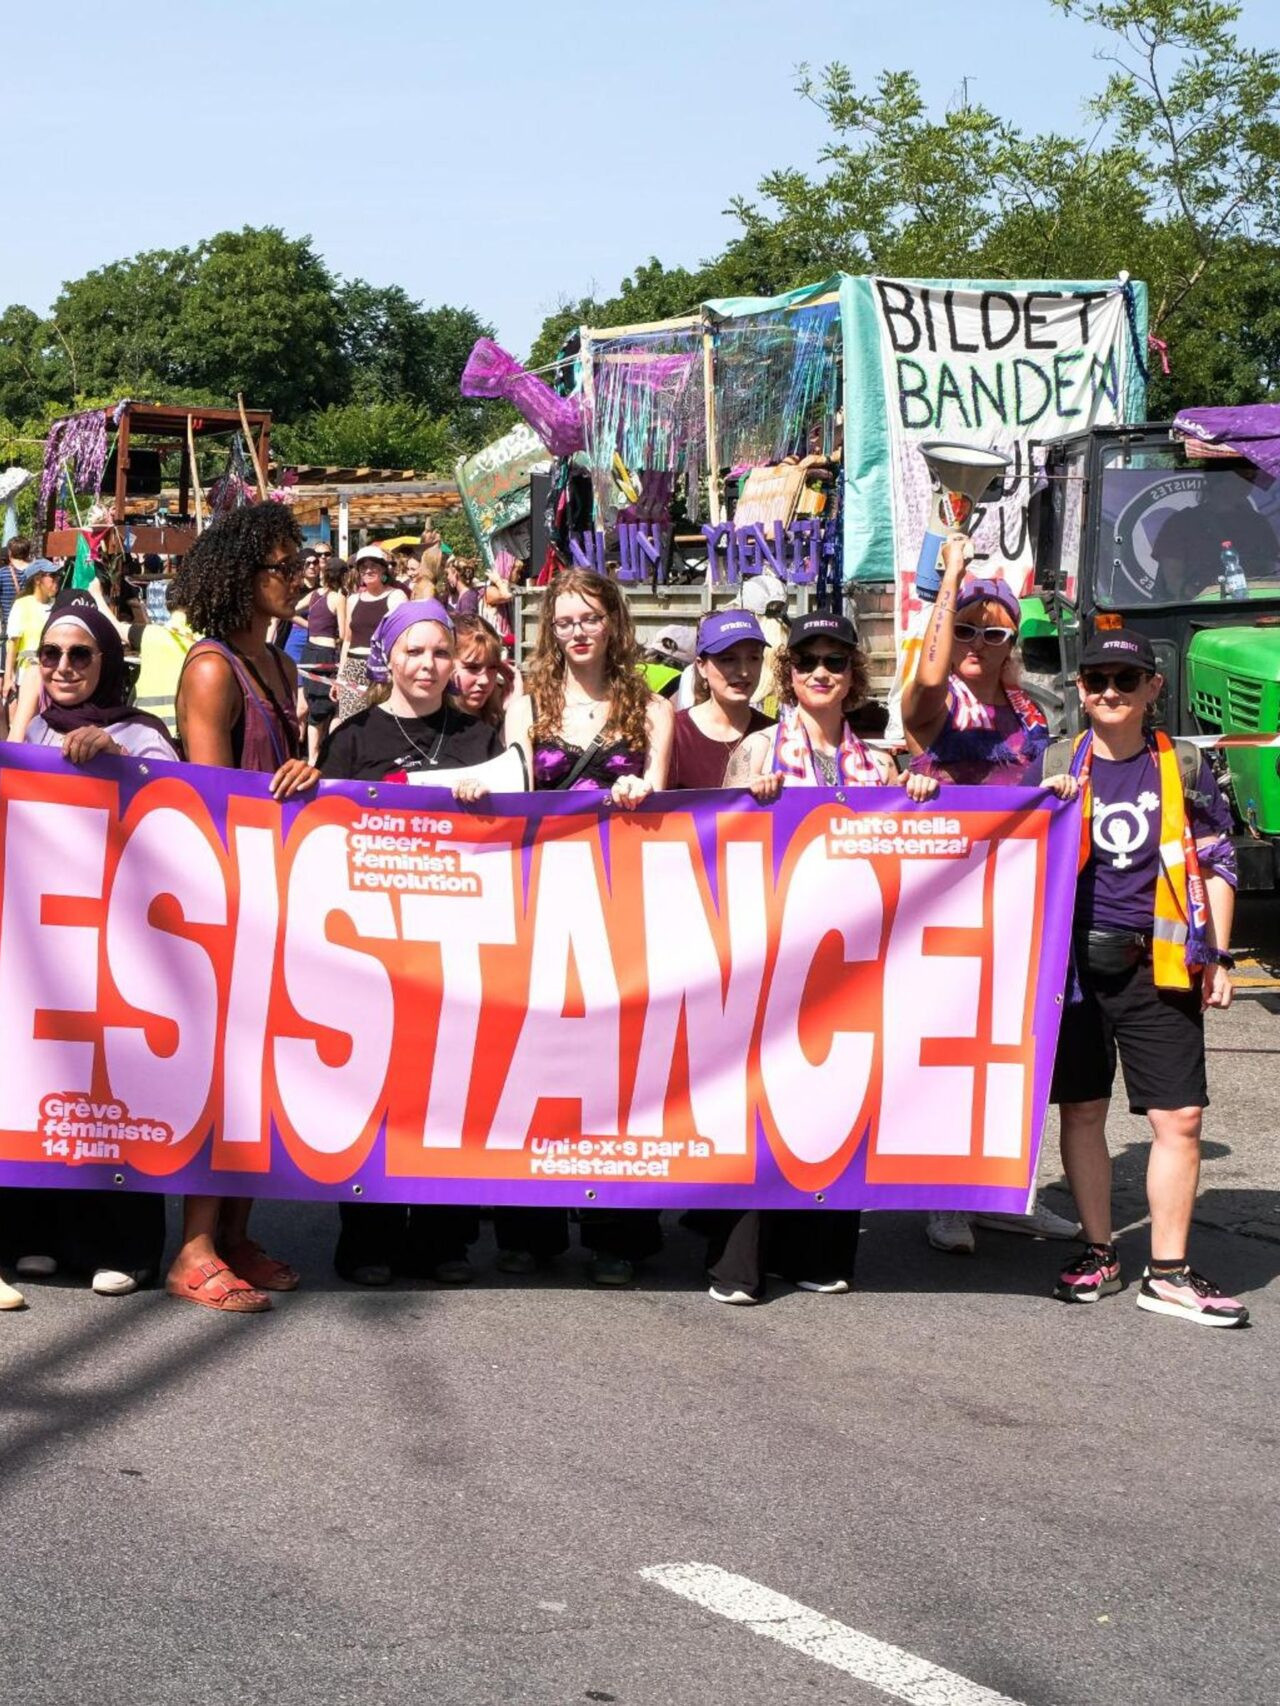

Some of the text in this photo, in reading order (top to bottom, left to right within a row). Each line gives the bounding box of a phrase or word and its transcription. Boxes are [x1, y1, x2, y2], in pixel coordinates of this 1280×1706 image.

[876, 279, 1107, 353] BILDET
[896, 345, 1119, 428] BANDEN
[928, 590, 951, 662] JUSTICE
[351, 813, 453, 834] Join the
[902, 816, 961, 835] nella
[351, 833, 431, 852] queer-
[830, 836, 969, 855] resistenza!
[352, 851, 456, 872] feminist
[353, 871, 478, 892] revolution
[44, 1098, 123, 1120] Grève
[43, 1117, 168, 1143] féministe
[41, 1139, 120, 1160] 14 juin
[642, 1140, 684, 1158] par
[688, 1139, 710, 1157] la
[530, 1155, 669, 1176] résistance!
